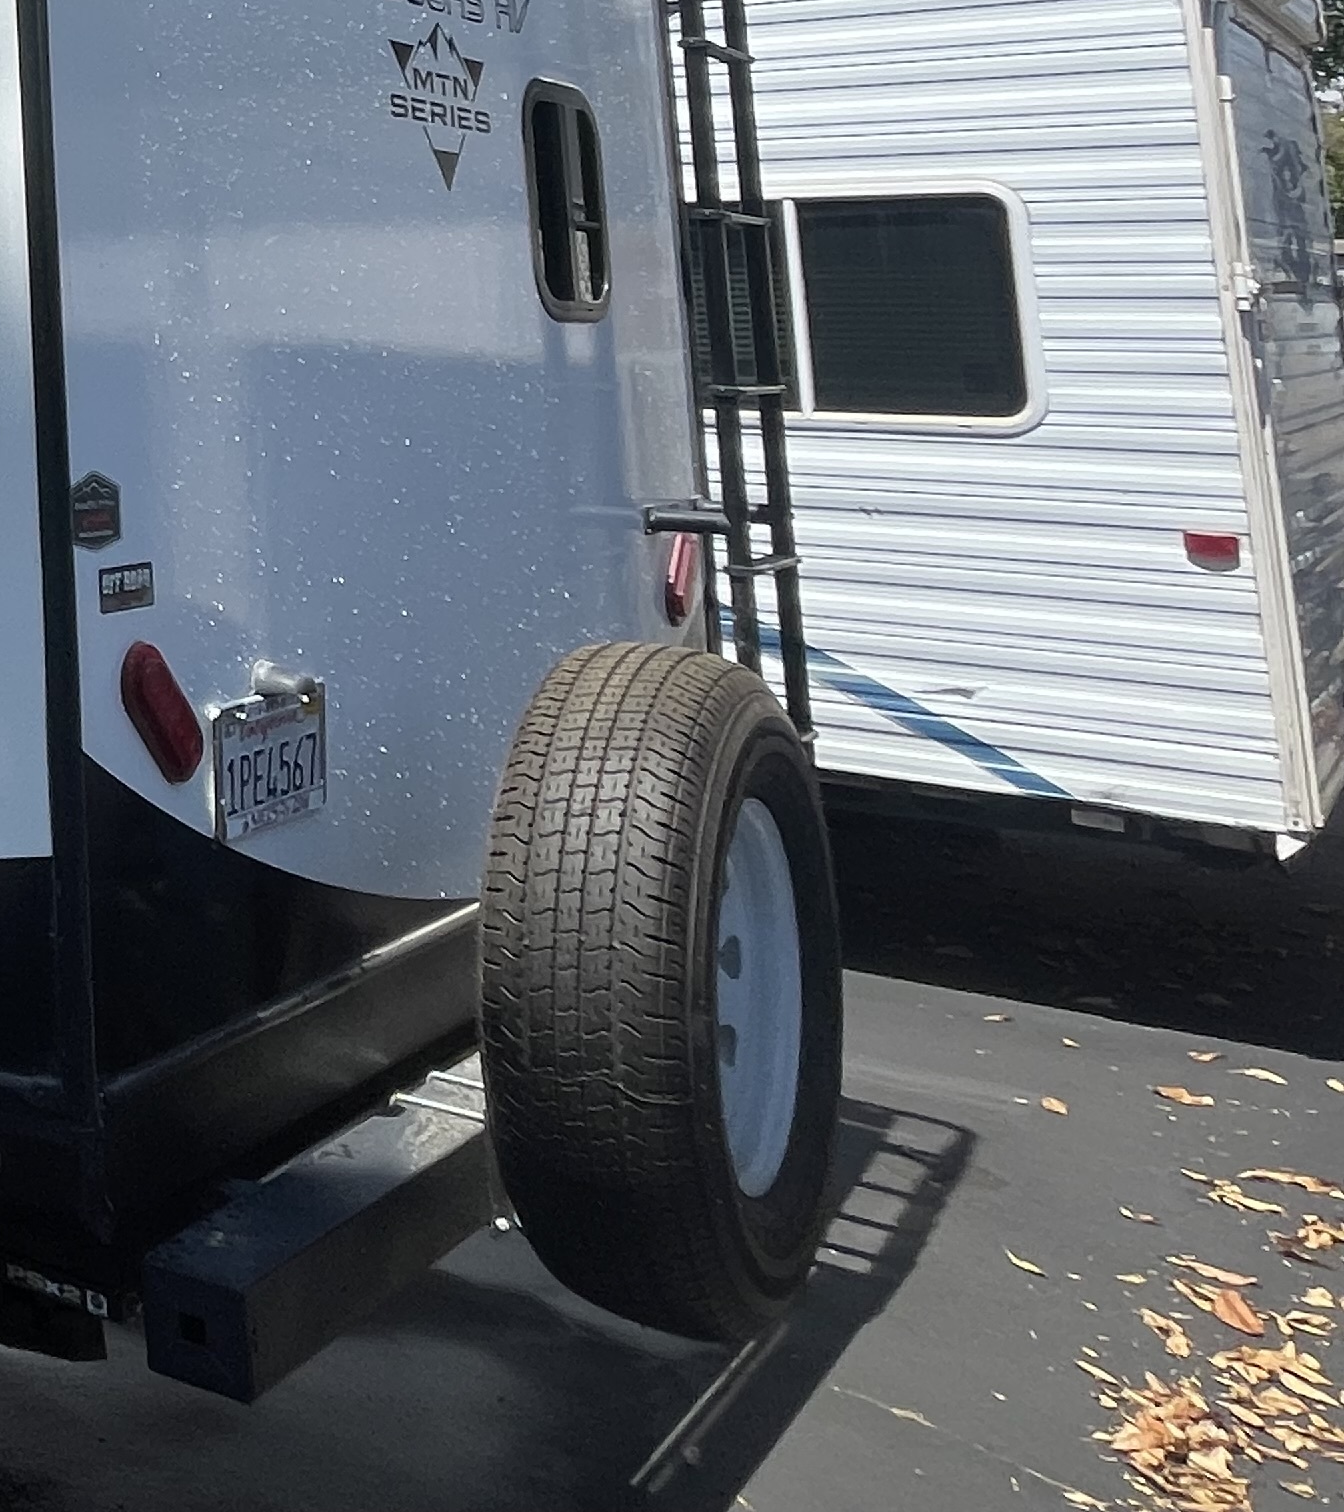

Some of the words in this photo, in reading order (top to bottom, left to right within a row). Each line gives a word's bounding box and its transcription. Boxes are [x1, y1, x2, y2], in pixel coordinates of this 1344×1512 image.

[412, 67, 469, 101] MTN
[390, 93, 491, 134] SERIES
[226, 732, 317, 817] 1PE4567
